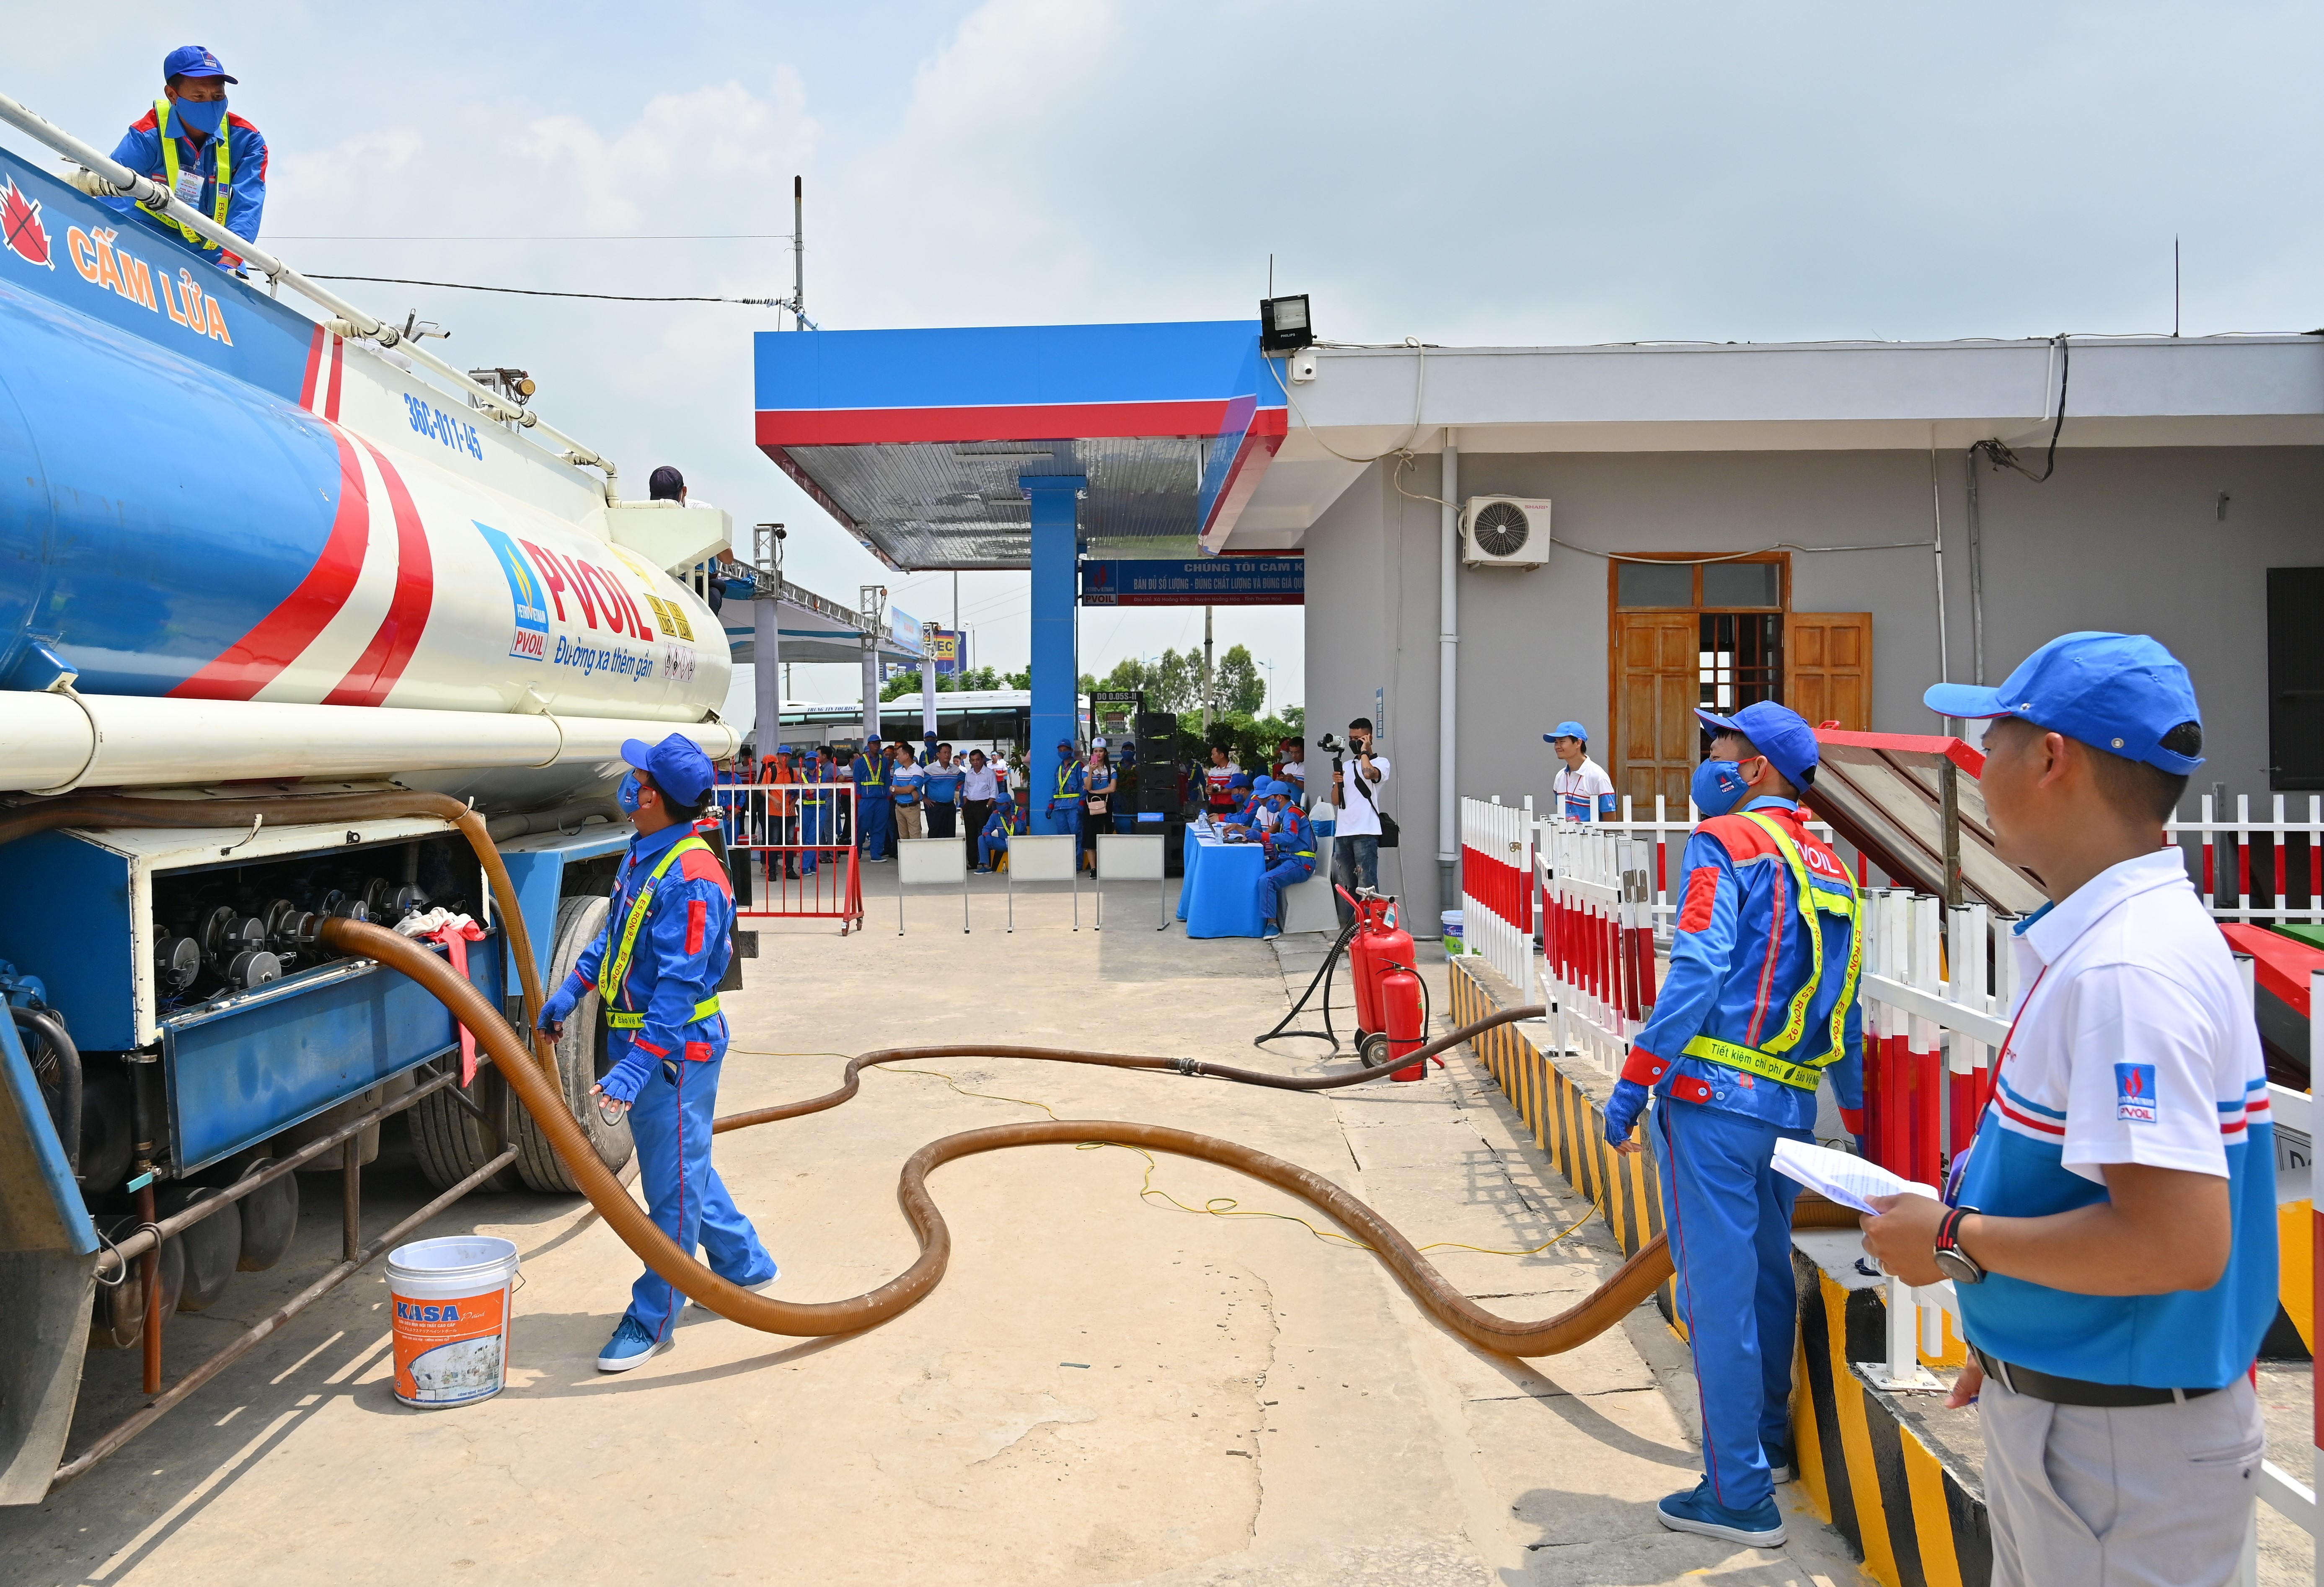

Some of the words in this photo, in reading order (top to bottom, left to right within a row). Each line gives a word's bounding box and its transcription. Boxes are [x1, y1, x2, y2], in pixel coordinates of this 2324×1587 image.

[67, 226, 159, 313] CẤM
[158, 267, 234, 346] LỬA
[404, 393, 483, 461] 36C-011-45
[1184, 562, 1230, 572] CHÚNG
[1235, 562, 1255, 571] TÔI
[1260, 563, 1290, 571] CAM
[517, 538, 654, 642] PVOIL
[1134, 576, 1147, 590] BÁN
[1148, 575, 1157, 590] ĐỦ
[1159, 574, 1167, 590] SỐ
[1168, 577, 1189, 592] LƯỢNG
[1195, 576, 1212, 589] ĐÚNG
[1214, 574, 1229, 589] CHẤT
[1231, 577, 1251, 592] LƯỢNG
[1253, 575, 1261, 589] VÀ
[1263, 575, 1280, 589] ĐÚNG
[1282, 575, 1292, 589] GIÁ
[517, 603, 546, 624] PETROVIETNAM
[514, 631, 543, 656] PVOIL
[554, 635, 595, 676] Đường
[595, 650, 610, 669] xa
[611, 647, 635, 675] thêm
[635, 649, 654, 682] gần
[637, 899, 646, 910] E5
[629, 911, 640, 930] RON
[626, 930, 633, 941] 92
[1855, 929, 1862, 944] E5
[621, 951, 627, 962] E5
[1850, 945, 1861, 972] RON
[613, 962, 623, 981] RON
[1847, 972, 1853, 986] 92
[600, 979, 605, 989] 92
[611, 981, 617, 992] 92
[1802, 986, 1815, 999] E5
[1794, 1000, 1804, 1026] RON
[1835, 1001, 1845, 1016] E5
[628, 1016, 636, 1026] Vệ
[1786, 1027, 1799, 1041] 92
[1833, 1044, 1841, 1057] 92
[1711, 1043, 1729, 1057] Tiết
[1731, 1049, 1752, 1065] kiệm
[1755, 1057, 1767, 1070] chi
[1768, 1063, 1783, 1075] phí
[1795, 1069, 1805, 1081] Bảo
[1806, 1075, 1813, 1086] Vệ
[2120, 1107, 2153, 1119] PVOIL
[397, 1300, 460, 1322] KASA
[461, 1310, 486, 1322] Paint
